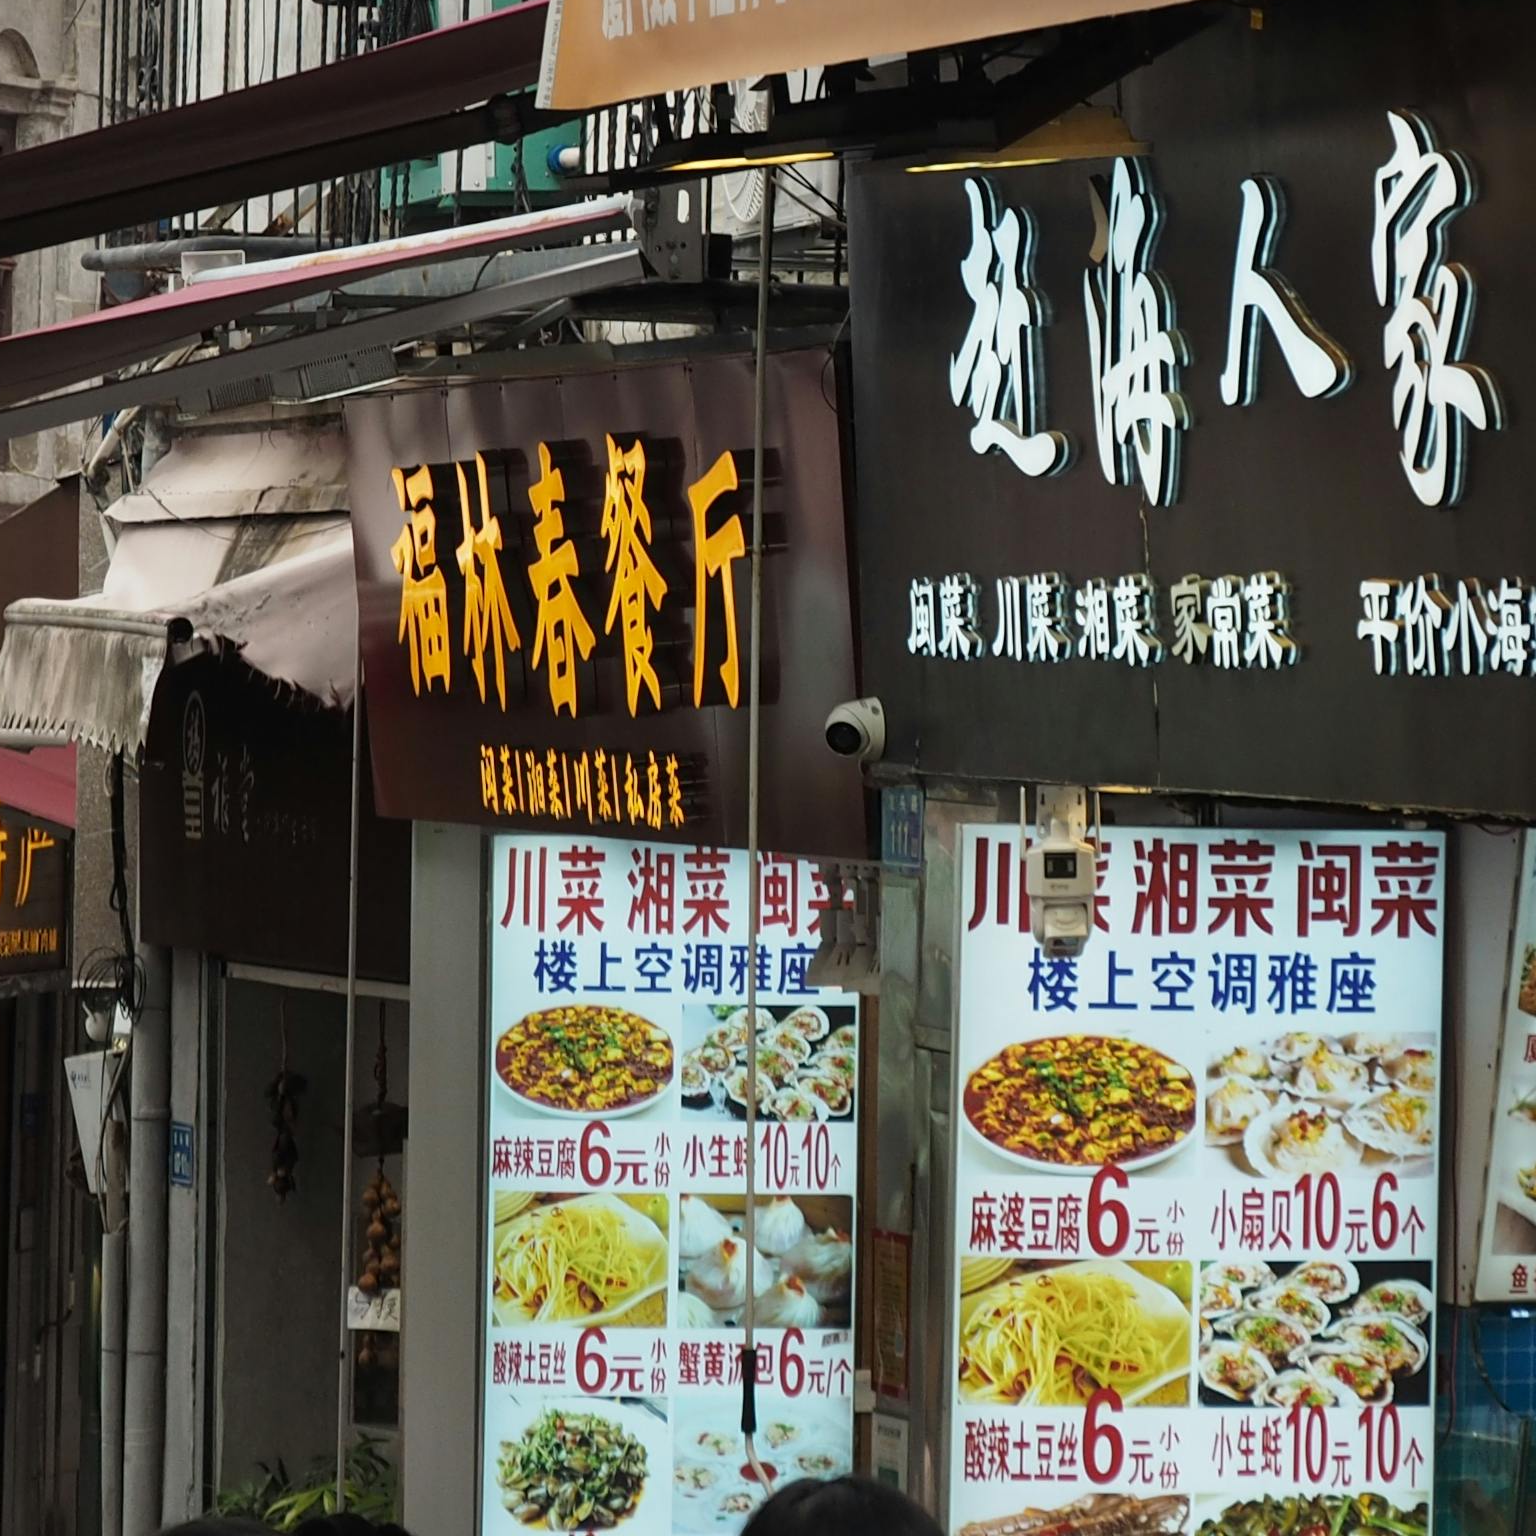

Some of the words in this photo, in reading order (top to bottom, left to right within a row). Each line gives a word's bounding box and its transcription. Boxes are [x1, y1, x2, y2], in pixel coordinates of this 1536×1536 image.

[390, 433, 746, 718] 福林春餐厅
[907, 578, 974, 660] 闽菜
[992, 578, 1066, 662] 川菜
[1075, 577, 1154, 666] 湘菜
[1170, 578, 1291, 667] 家常菜
[501, 845, 606, 936] 川菜
[627, 845, 731, 938] 湘菜
[1130, 837, 1274, 938] 湘菜
[1296, 839, 1440, 940] 闽菜
[533, 938, 822, 996] 楼上空调雅座
[1027, 947, 1377, 1016] 楼上空调雅座
[1210, 1170, 1427, 1257] 小扇贝10元6个
[1211, 1387, 1425, 1489] 小生蚝10元10个
